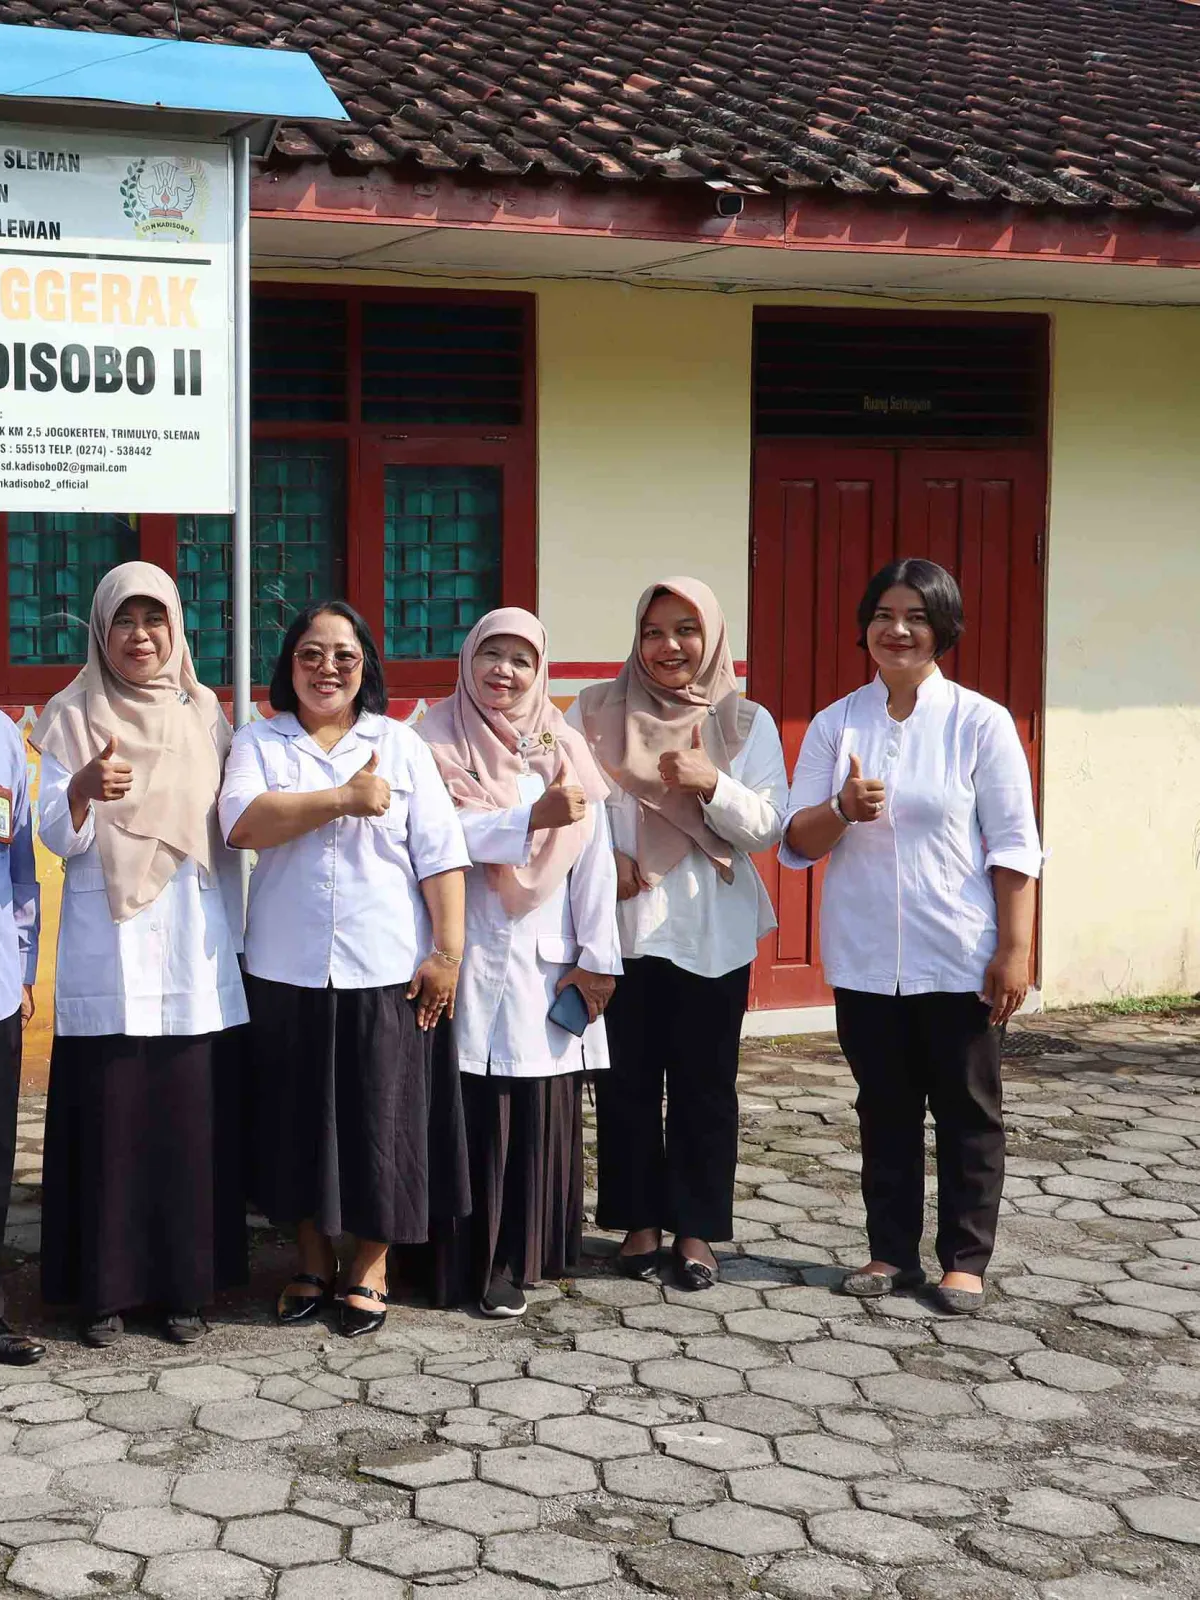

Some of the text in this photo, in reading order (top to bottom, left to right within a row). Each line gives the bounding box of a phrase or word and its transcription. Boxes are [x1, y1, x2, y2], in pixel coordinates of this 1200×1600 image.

[3, 149, 81, 174] SLEMAN
[156, 221, 190, 232] KADISOBO
[173, 348, 202, 397] II
[8, 426, 24, 437] KM
[44, 427, 109, 439] JOGOKERTEN,
[111, 428, 160, 441] TRIMULYO,
[163, 429, 200, 441] SLEMAN
[15, 443, 46, 455] 55513
[48, 444, 73, 455] TELP.
[75, 444, 107, 457] (0274)
[116, 445, 152, 456] 538442
